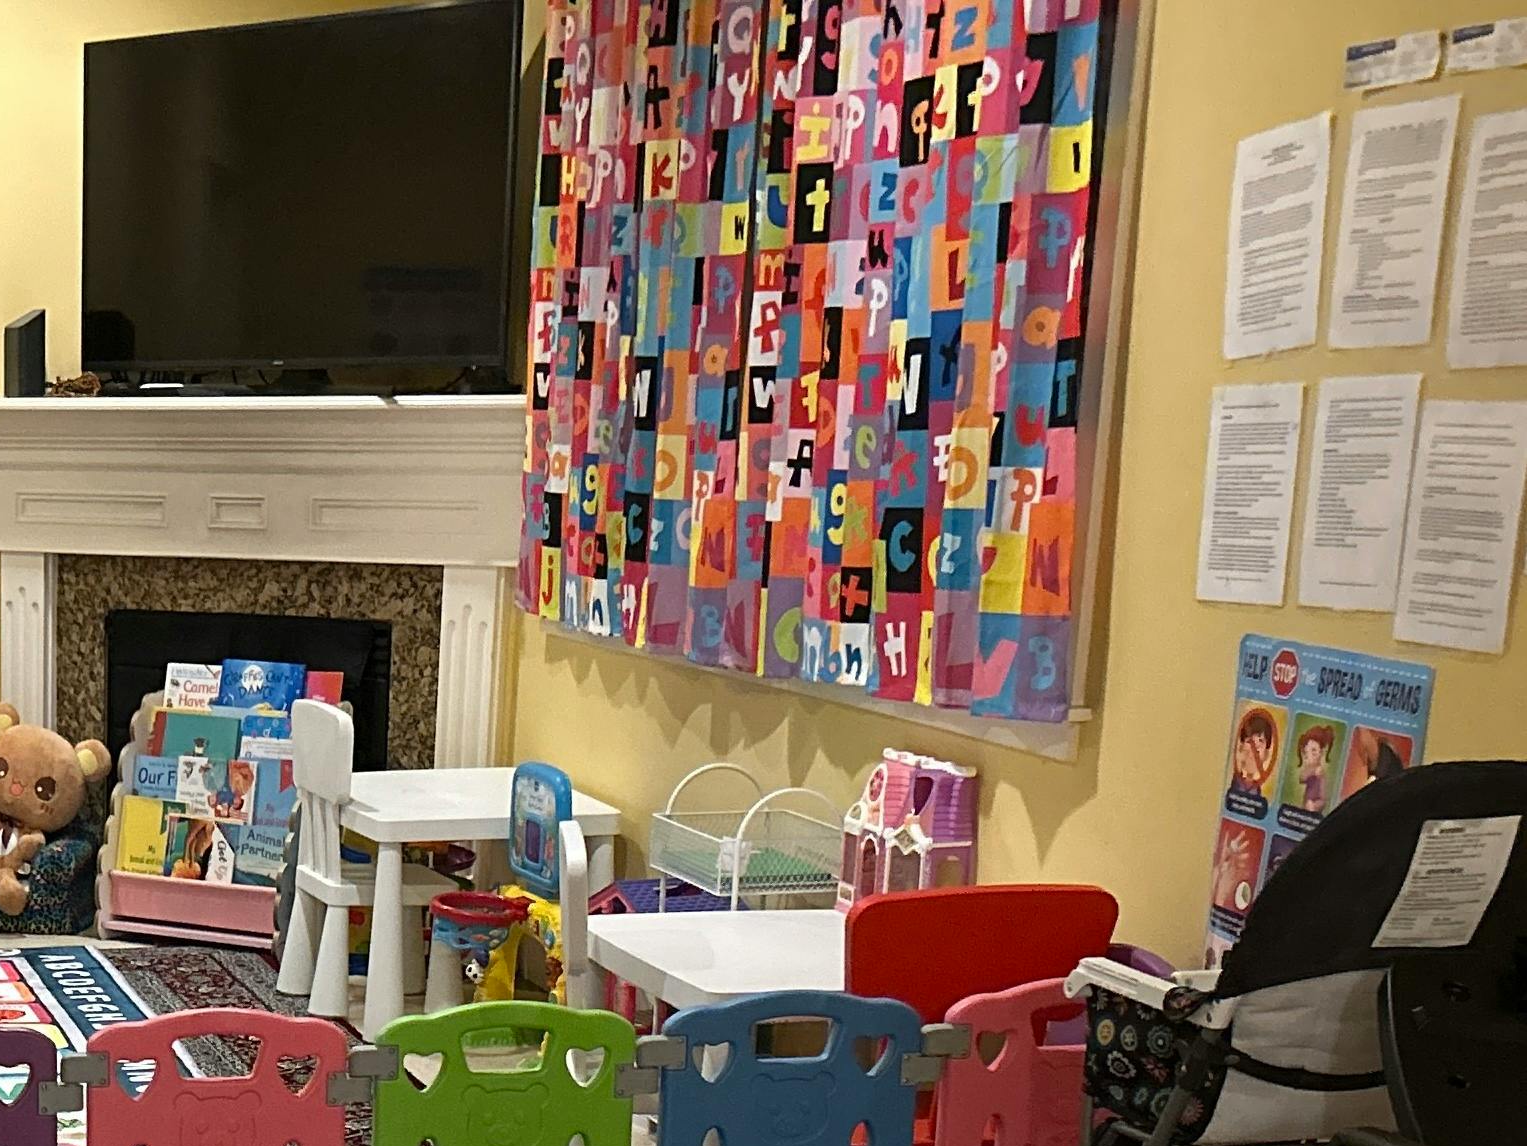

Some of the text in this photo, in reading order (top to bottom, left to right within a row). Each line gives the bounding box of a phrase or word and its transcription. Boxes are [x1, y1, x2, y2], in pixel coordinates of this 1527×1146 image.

[1273, 662, 1297, 683] STOP
[1317, 666, 1363, 700] SPREAD
[1375, 679, 1422, 714] GERMS
[178, 694, 206, 707] Have
[138, 767, 164, 785] Our
